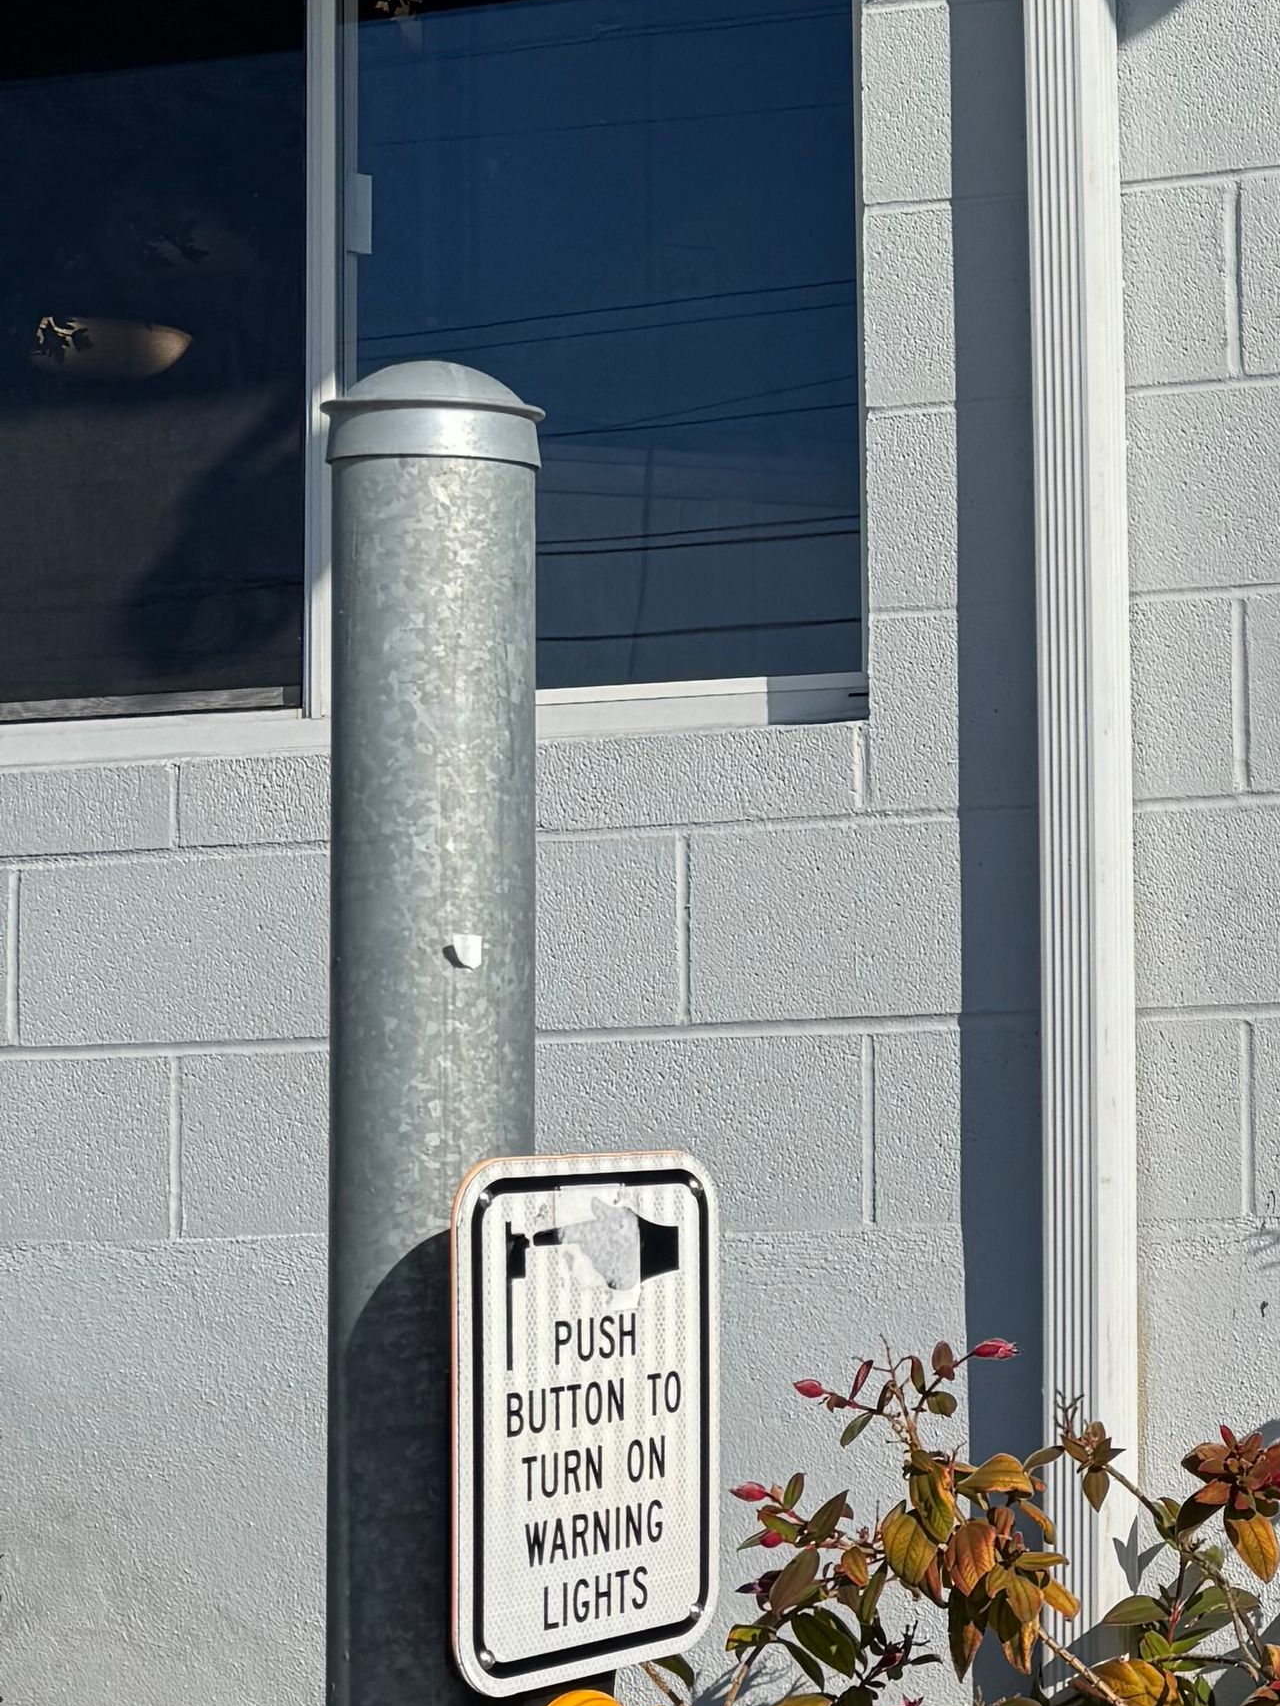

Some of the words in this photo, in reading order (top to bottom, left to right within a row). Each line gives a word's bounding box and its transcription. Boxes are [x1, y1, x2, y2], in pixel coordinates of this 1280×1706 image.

[554, 1312, 637, 1366] PUSH
[506, 1377, 625, 1439] BUTTON
[647, 1369, 682, 1414] TO
[522, 1444, 603, 1502] TURN
[627, 1435, 667, 1484] ON
[525, 1499, 664, 1568] WARNING
[543, 1566, 649, 1632] LIGHTS
